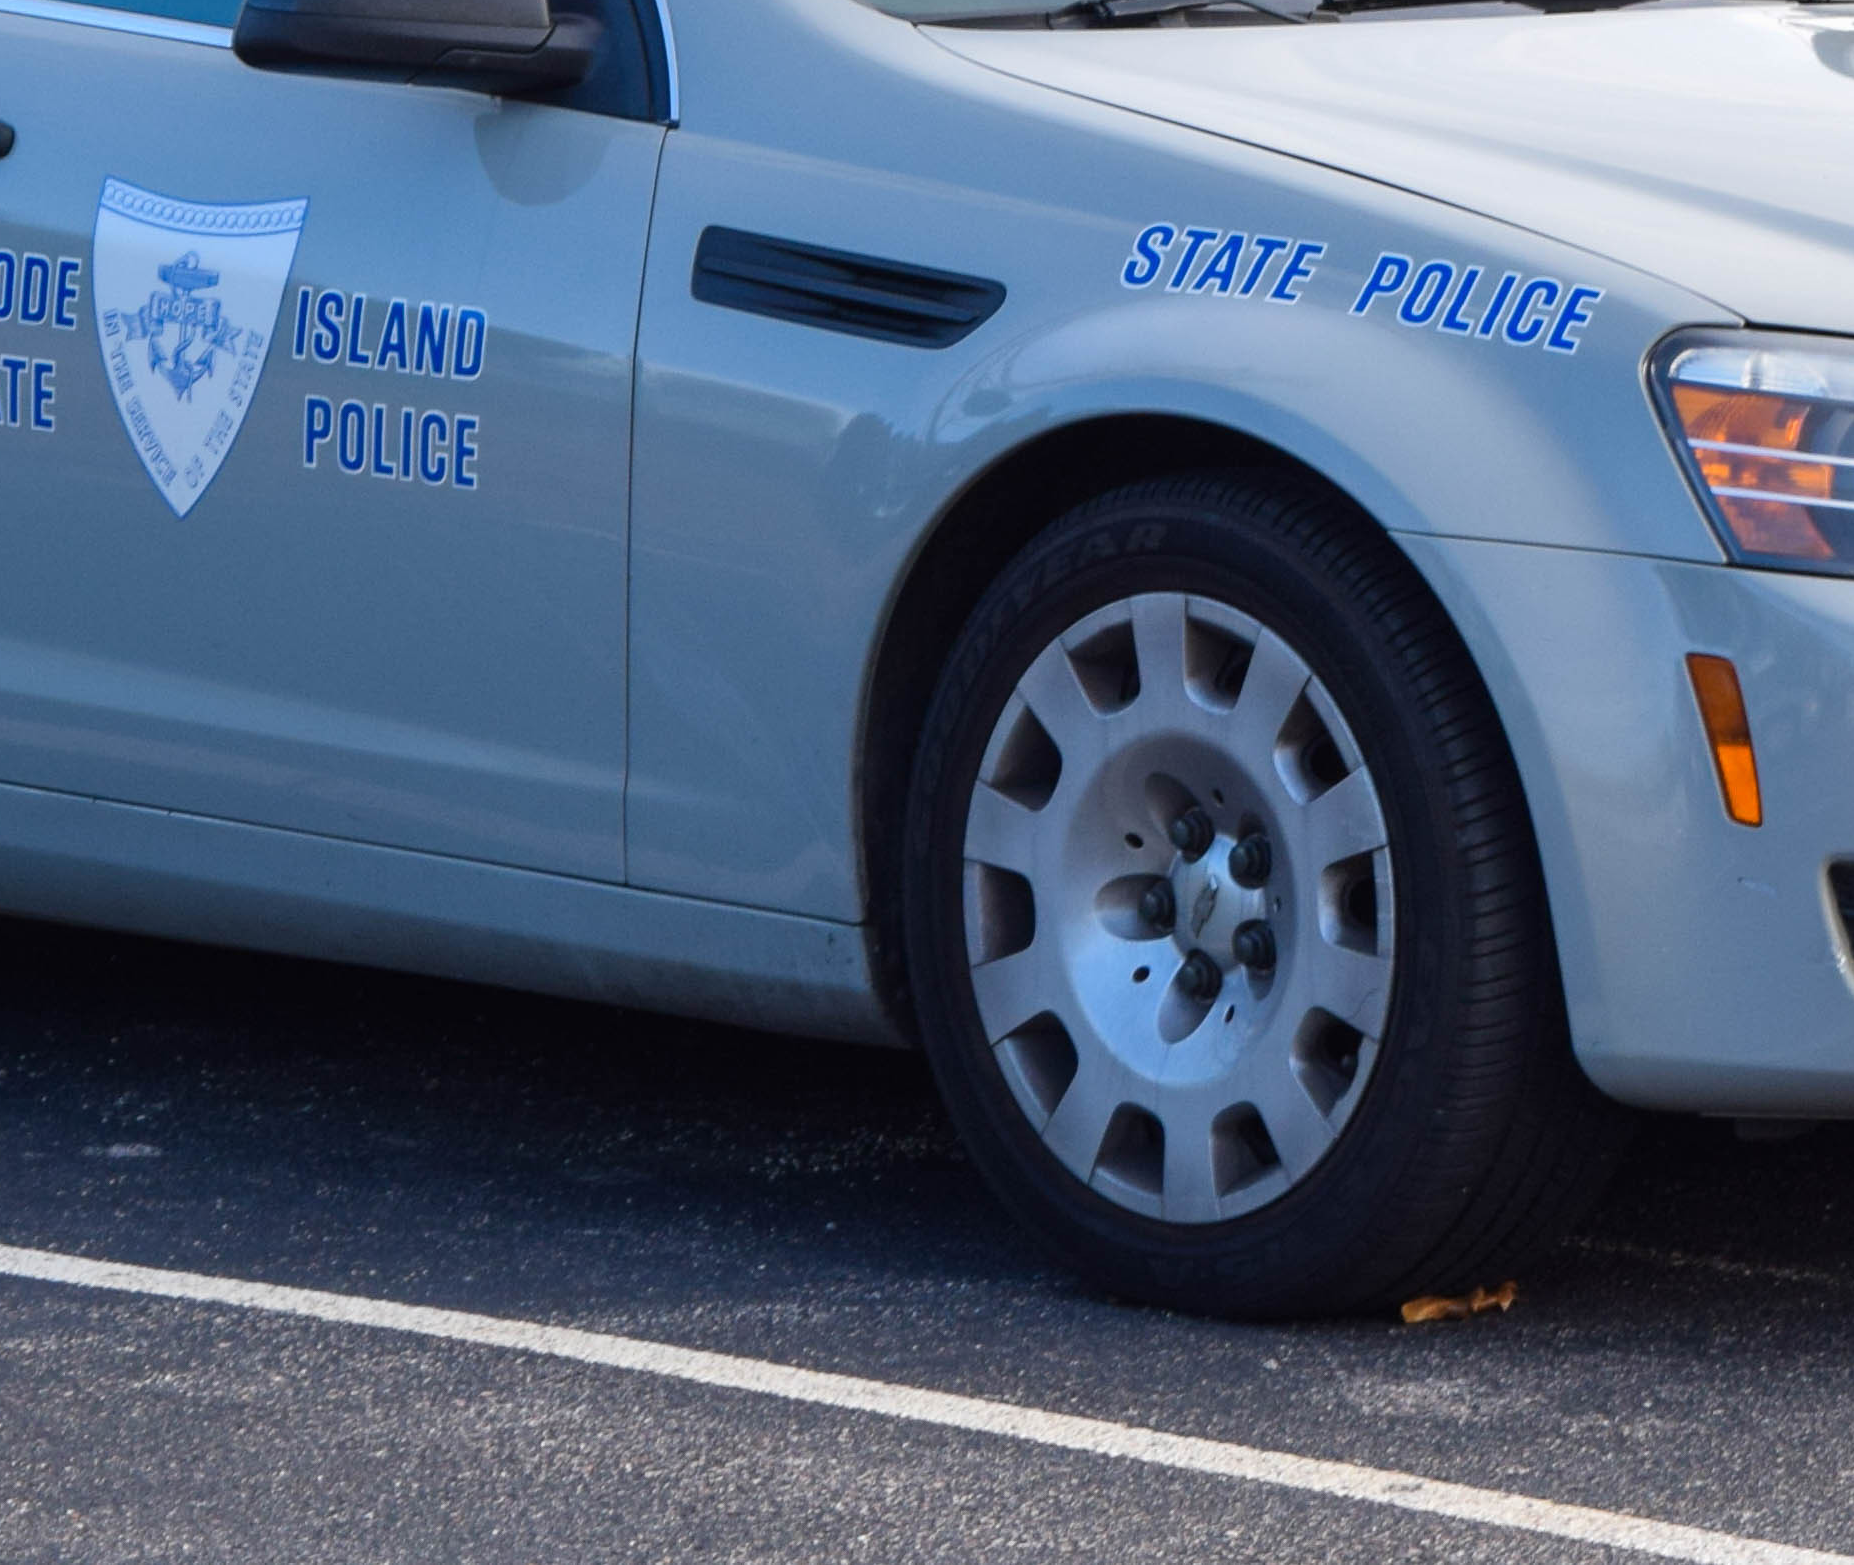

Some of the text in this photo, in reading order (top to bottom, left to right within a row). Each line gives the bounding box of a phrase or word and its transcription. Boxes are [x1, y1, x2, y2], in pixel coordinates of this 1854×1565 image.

[292, 286, 486, 381] ISLAND
[1120, 222, 1607, 355] STATE POLICE
[302, 394, 480, 491] POLICE
